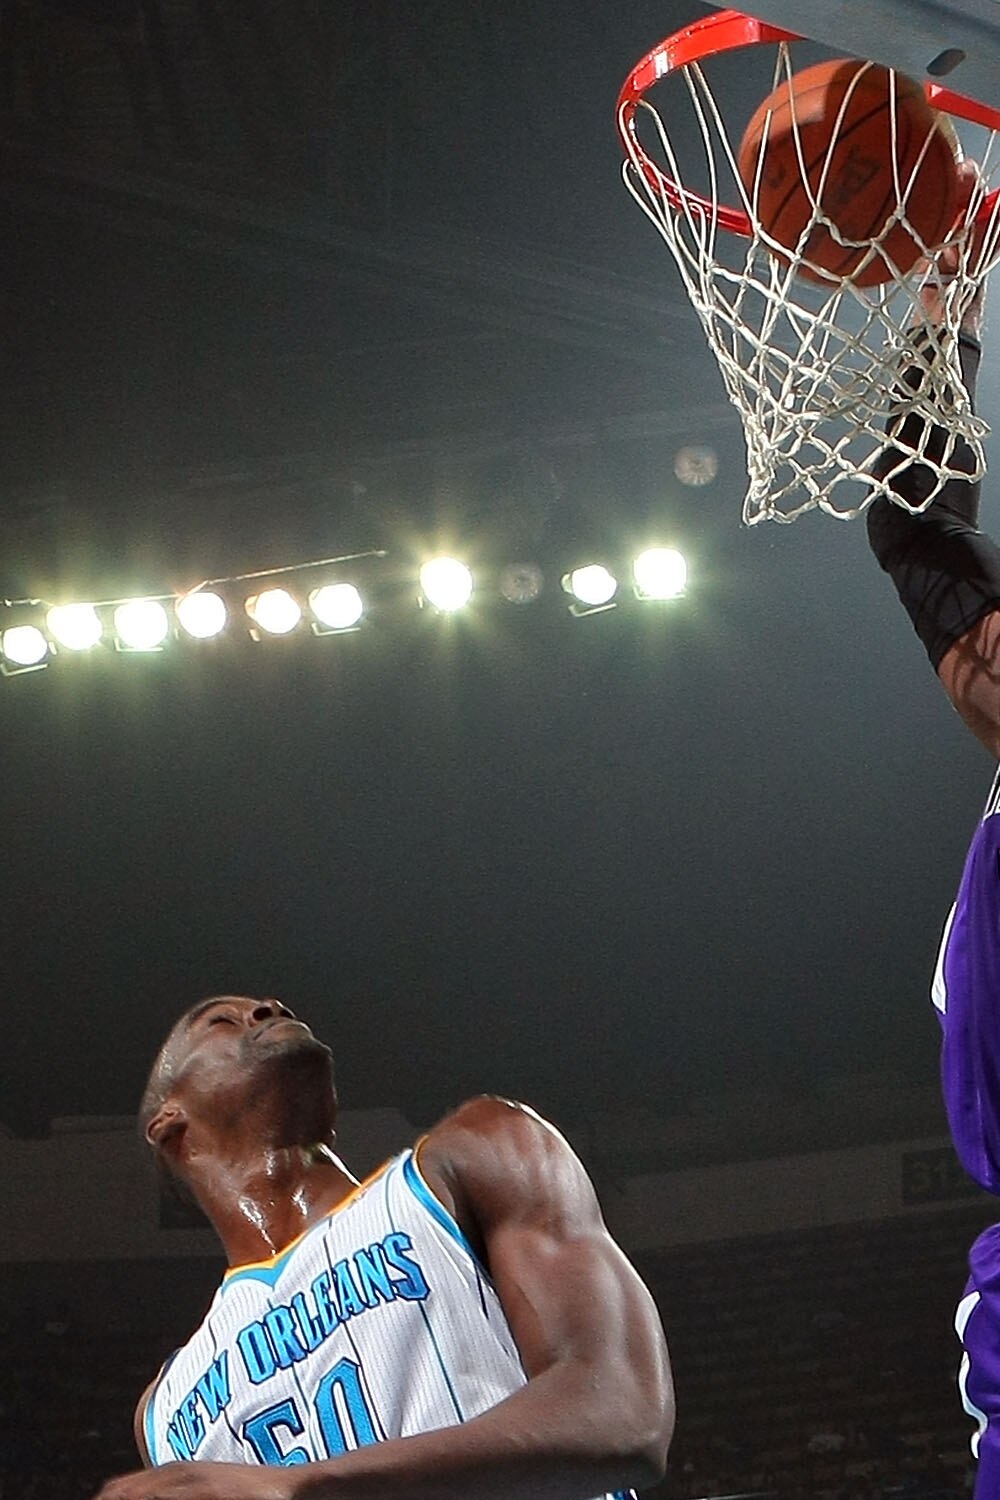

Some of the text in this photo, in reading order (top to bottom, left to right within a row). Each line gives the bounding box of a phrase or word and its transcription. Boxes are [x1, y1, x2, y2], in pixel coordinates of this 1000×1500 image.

[167, 1231, 431, 1462] NEW ORLEANS
[242, 1356, 383, 1467] 50
